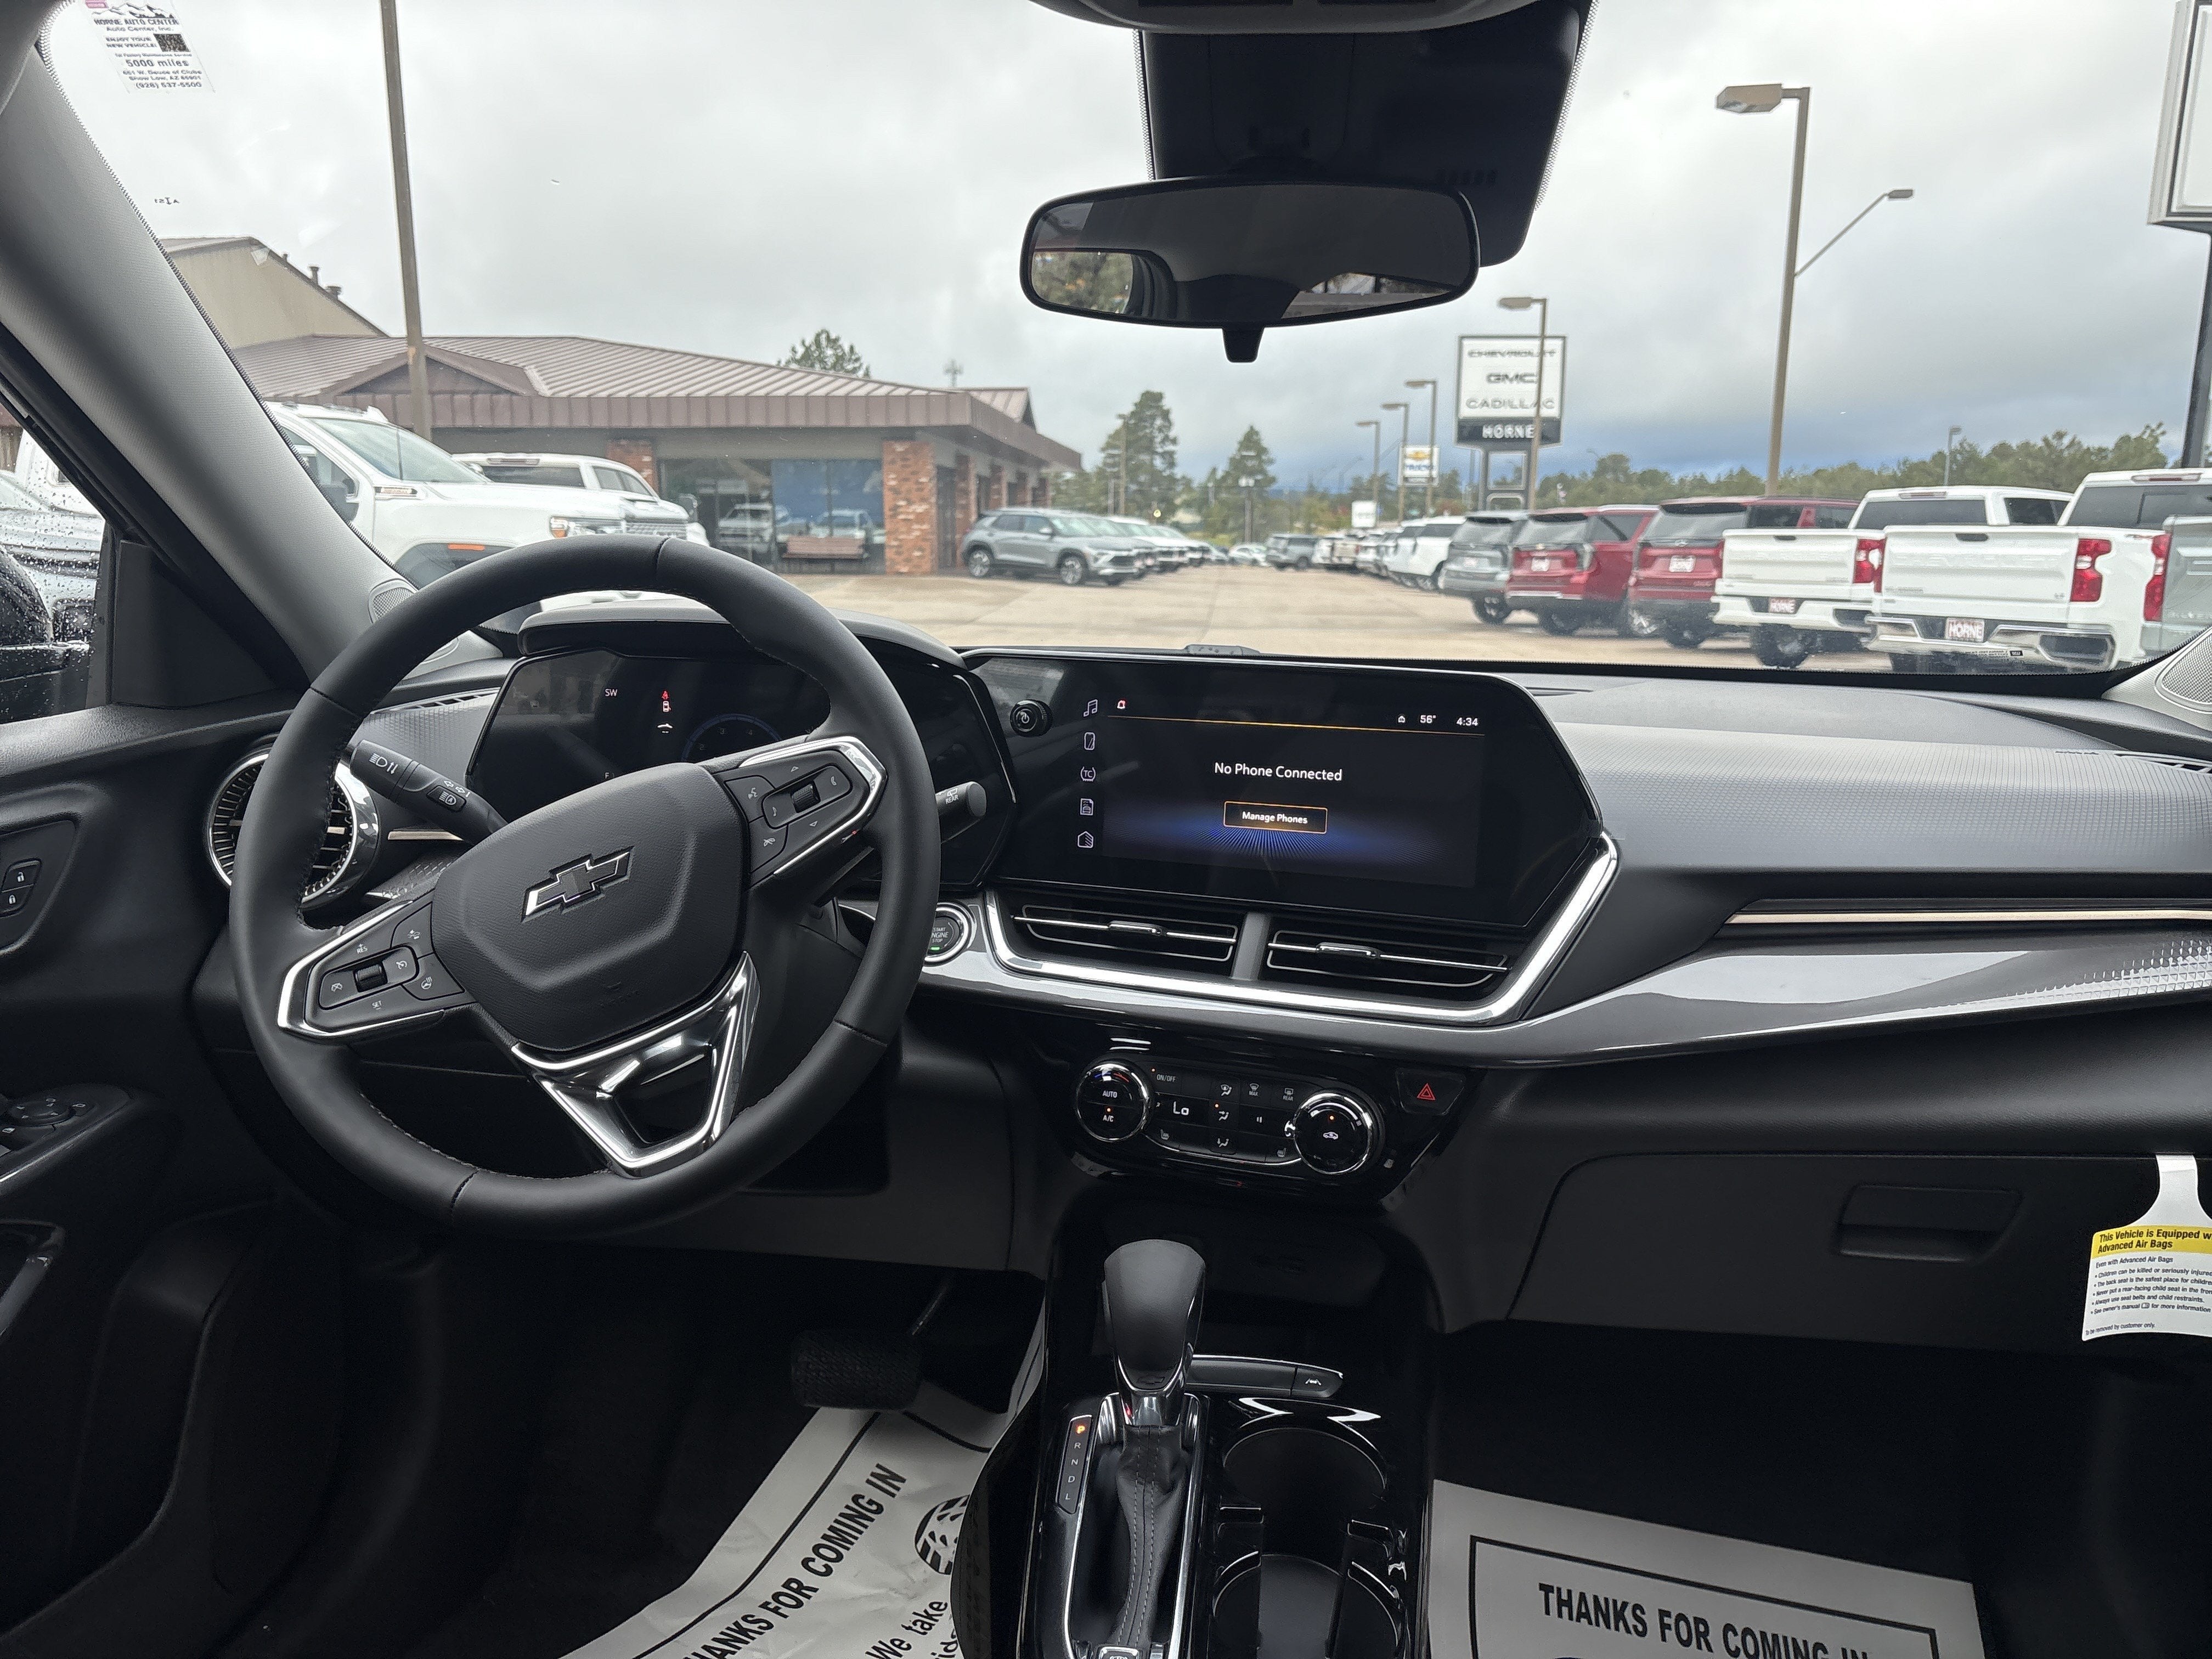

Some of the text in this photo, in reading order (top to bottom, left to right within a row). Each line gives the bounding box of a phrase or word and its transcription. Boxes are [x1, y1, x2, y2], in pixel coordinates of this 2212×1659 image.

[125, 59, 189, 67] 5000 miles
[1468, 349, 1556, 358] CHEVROLT
[1486, 373, 1537, 383] GMC
[1482, 424, 1535, 438] HORNE
[1949, 621, 1983, 639] HORNE
[605, 689, 618, 697] SW
[1456, 717, 1479, 726] 4:34
[1083, 770, 1093, 778] TC
[1214, 761, 1343, 782] No Phone Connected
[945, 794, 960, 805] REAR
[1242, 811, 1308, 824] Manage Phones
[356, 946, 368, 954] RES
[1156, 1074, 1177, 1082] ON/OFF
[1102, 1090, 1118, 1098] AUTO
[1102, 1114, 1114, 1122] A/C
[2099, 1232, 2114, 1243] This
[2115, 1229, 2144, 1240] Vehicle
[2146, 1228, 2154, 1237] is
[2156, 1228, 2200, 1240] Equipped
[2097, 1239, 2174, 1254] Advanced Air Bags
[2162, 1267, 2190, 1276] seriously
[2176, 1304, 2211, 1313] information
[1076, 1425, 1086, 1434] P
[758, 1577, 820, 1619] FOR
[801, 1493, 884, 1577] COMING
[865, 1463, 907, 1499] IN
[900, 1601, 948, 1635] take
[1538, 1582, 1647, 1638] THANKS
[1658, 1608, 1714, 1653] FOR
